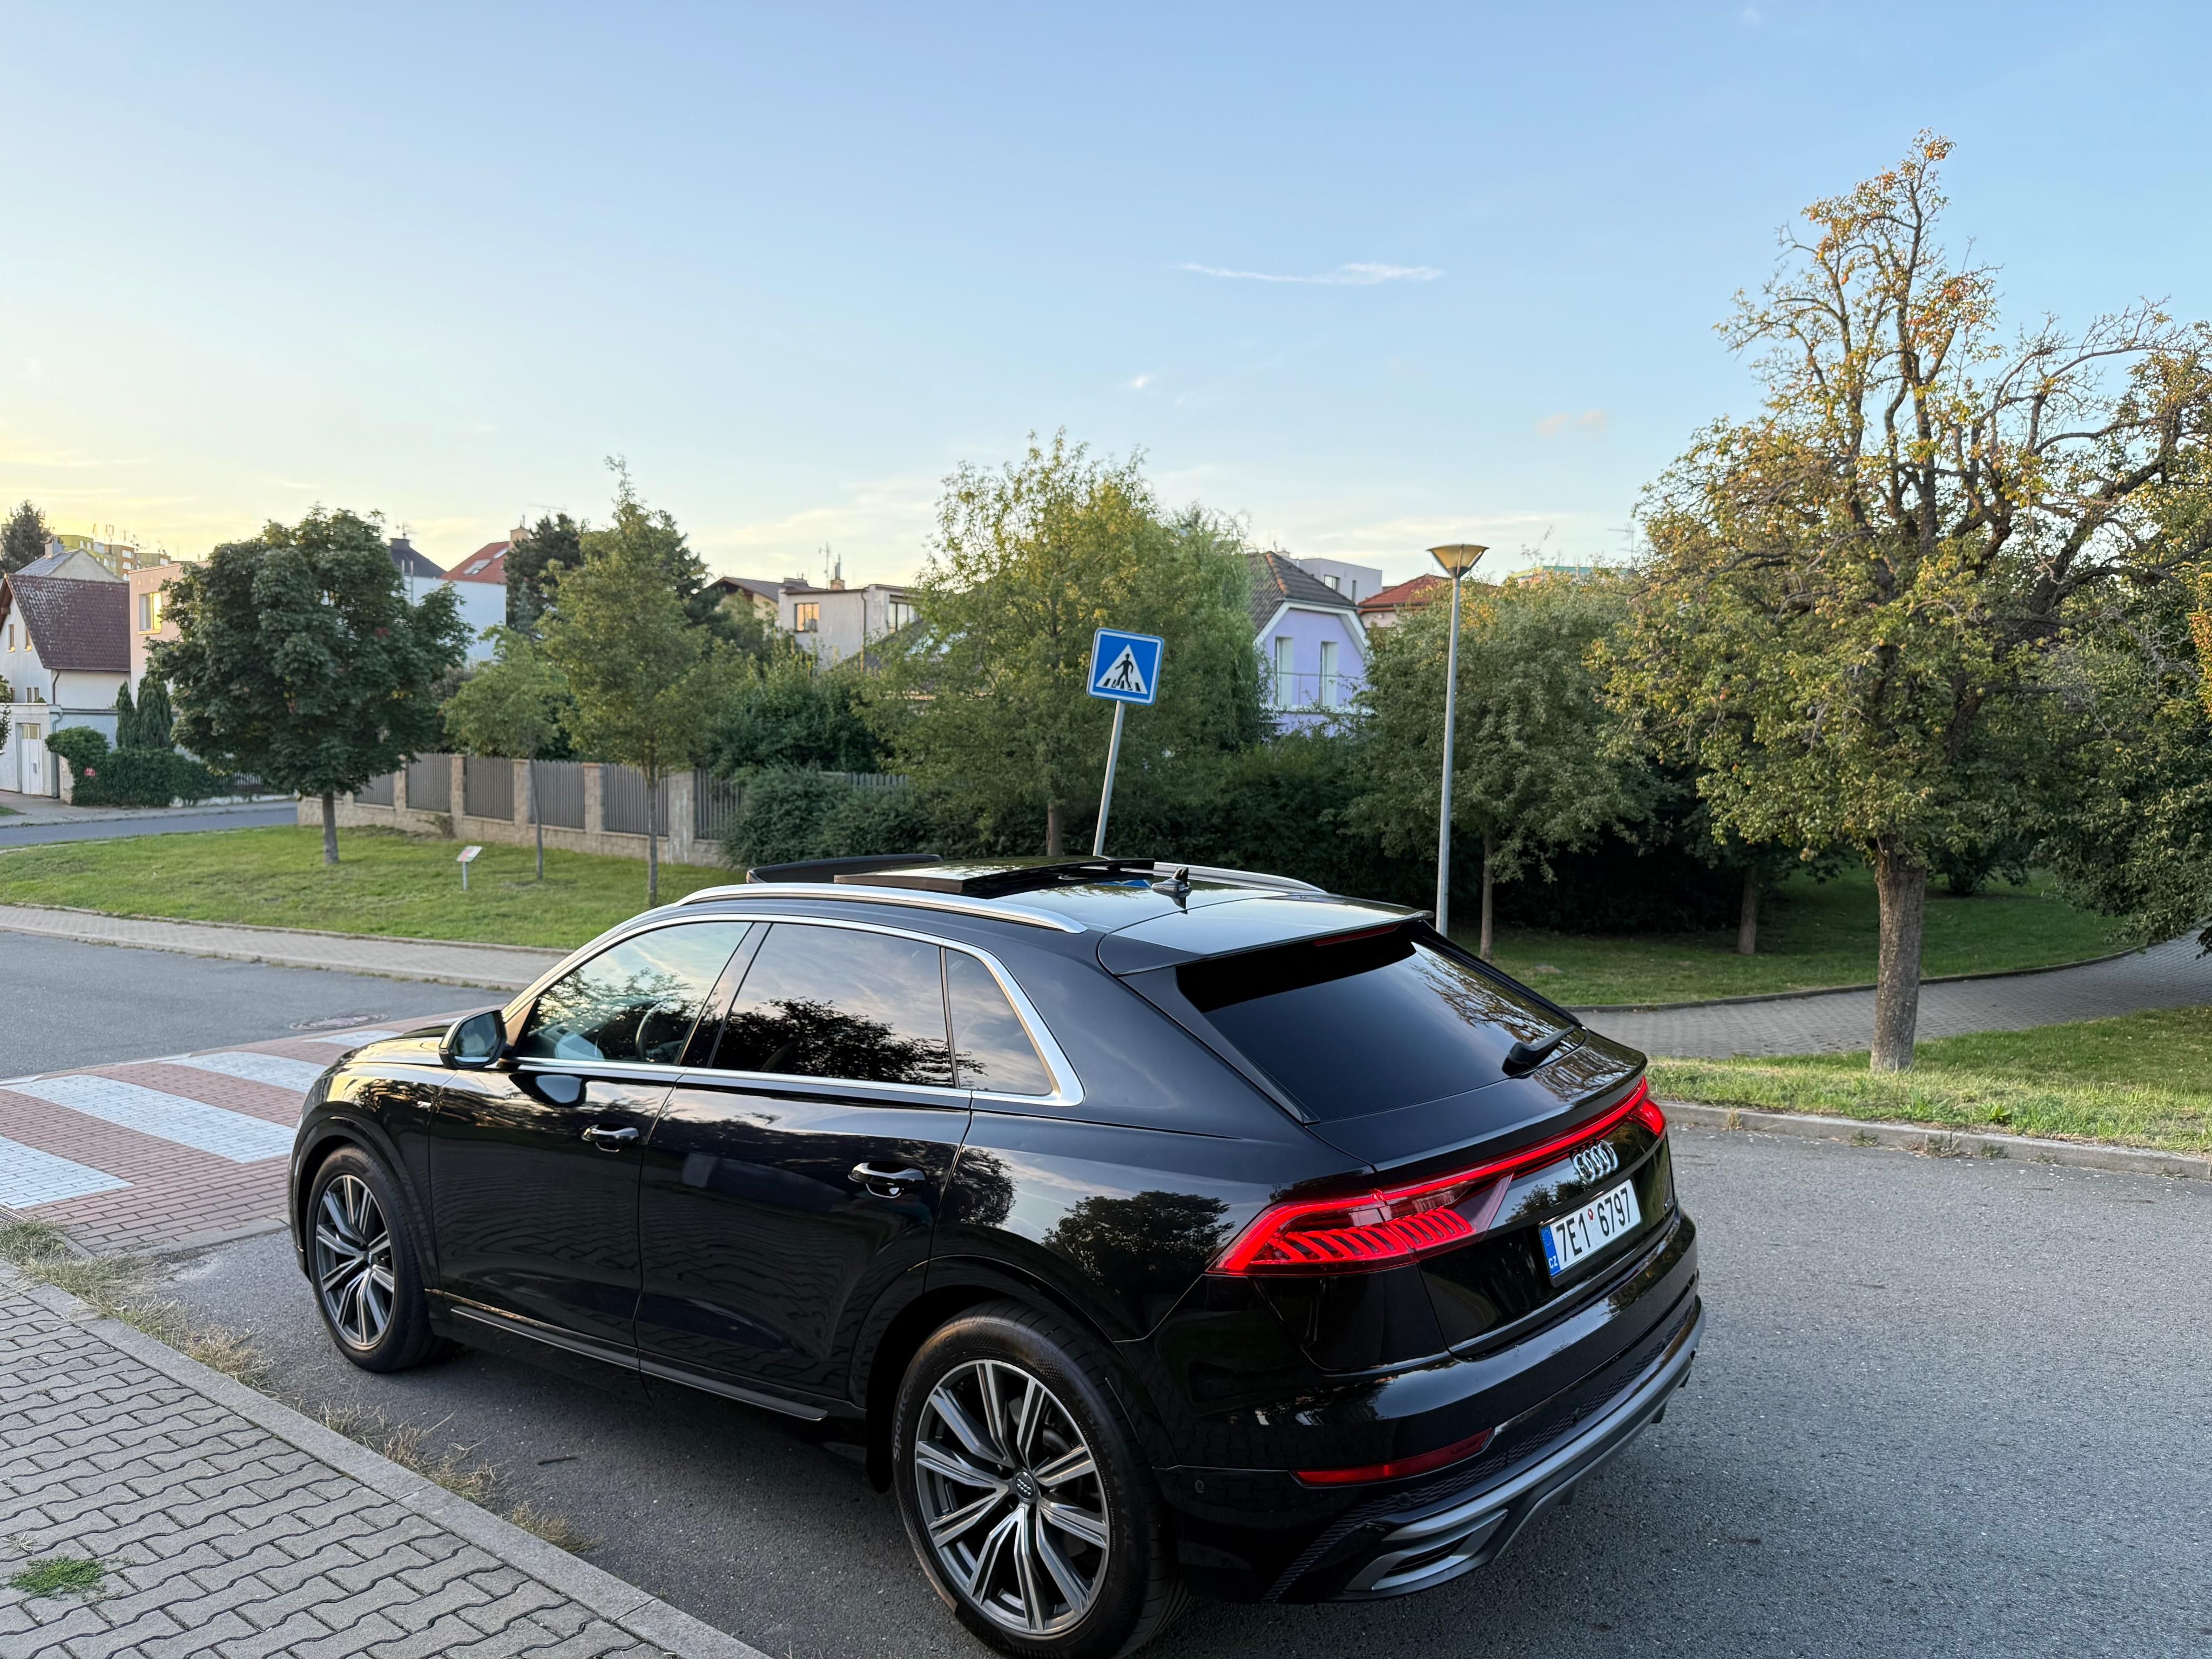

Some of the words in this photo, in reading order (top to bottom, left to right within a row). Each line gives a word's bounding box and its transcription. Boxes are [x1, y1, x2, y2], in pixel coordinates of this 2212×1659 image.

[1556, 1212, 1591, 1262] 7E1
[1597, 1187, 1630, 1237] 6797
[1548, 1256, 1558, 1269] CZ
